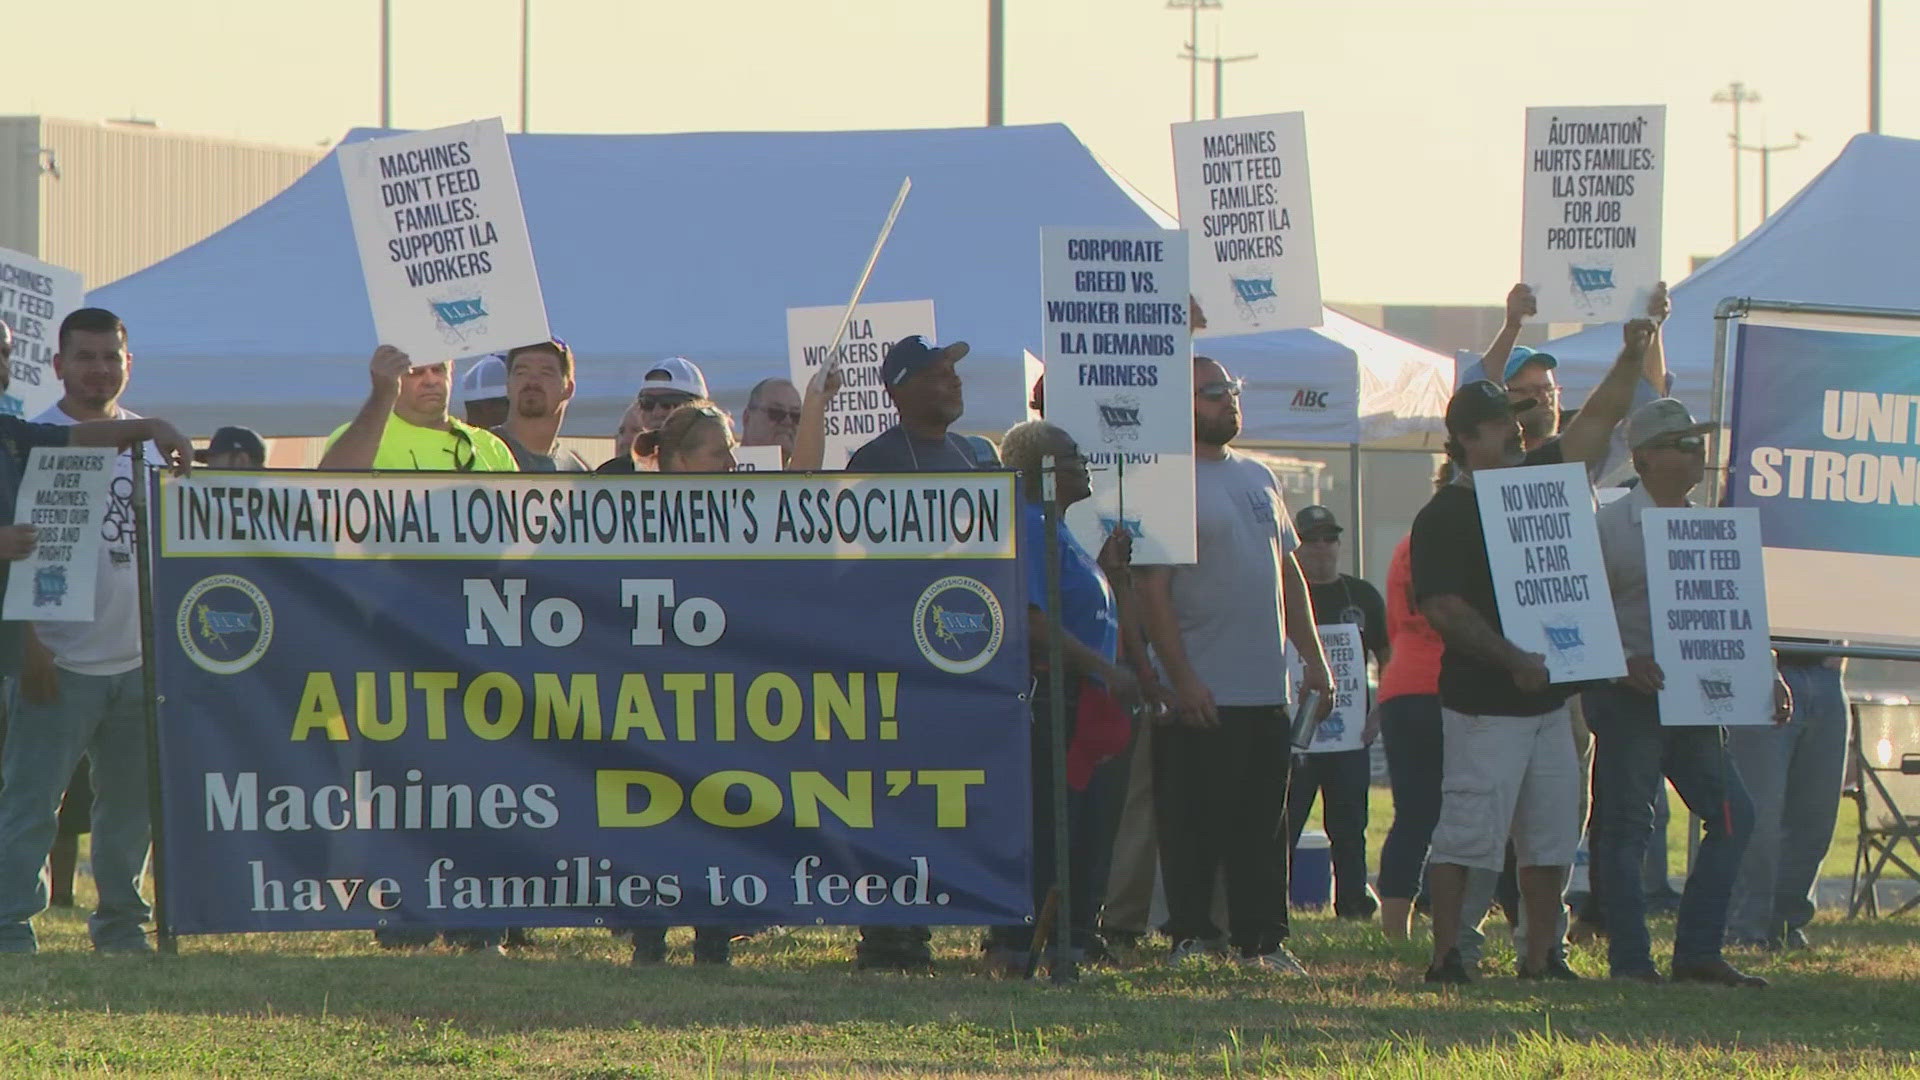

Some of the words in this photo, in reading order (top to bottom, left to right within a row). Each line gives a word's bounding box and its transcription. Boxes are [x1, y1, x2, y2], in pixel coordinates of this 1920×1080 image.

[1203, 131, 1276, 158] MACHINES
[1549, 122, 1641, 145] AUTOMATION
[379, 141, 471, 180] MACHINES
[1203, 160, 1243, 185] DON'T
[1247, 157, 1281, 181] FEED
[1535, 149, 1581, 172] HURTS
[1585, 149, 1655, 171] FAMILIES:
[381, 177, 432, 207] DON'T
[436, 168, 480, 197] FEED
[1211, 183, 1278, 211] FAMILIES:
[1552, 176, 1575, 198] ILA
[1579, 175, 1634, 197] STANDS
[394, 197, 480, 233] FAMILIES:
[1203, 211, 1264, 237] SUPPORT
[1269, 209, 1290, 231] ILA
[1564, 201, 1591, 224] FOR
[1595, 201, 1620, 223] JOB
[388, 227, 465, 262] SUPPORT
[470, 221, 499, 247] ILA
[1068, 239, 1163, 262] CORPORATE
[1215, 235, 1283, 262] WORKERS
[1548, 227, 1636, 250] PROTECTION
[405, 251, 492, 288] WORKERS
[1075, 270, 1125, 293] GREED
[1132, 271, 1158, 294] VS.
[19, 292, 54, 320] FEED
[1048, 301, 1119, 324] WORKER
[1125, 303, 1187, 326] RIGHTS:
[849, 319, 873, 340] ILA
[803, 342, 878, 366] WOKERS
[1061, 332, 1087, 354] ILA
[1093, 333, 1174, 356] DEMANDS
[1079, 364, 1158, 387] FAIRNESS
[1291, 390, 1329, 408] ABC
[843, 414, 875, 435] AND
[56, 455, 104, 471] WORKERS
[54, 473, 80, 488] OVER
[1749, 447, 1920, 506] STRON
[1501, 484, 1523, 512] NO
[1524, 481, 1569, 510] WORK
[31, 509, 68, 524] DEFEND
[69, 509, 90, 524] OUR
[177, 485, 440, 544] INTERNATIONAL
[453, 487, 758, 545] LONGSHOREMEN'S
[774, 487, 1000, 545] ASSOCIATION
[60, 528, 80, 543] AND
[1507, 512, 1572, 543] WITHOUT
[1667, 519, 1737, 540] MACHINES
[37, 545, 72, 561] RIGHTS
[1524, 547, 1536, 574] A
[1537, 545, 1571, 573] FAIR
[1669, 549, 1706, 571] DON'T
[1710, 550, 1740, 570] FEED
[1515, 575, 1590, 607] CONTRACT
[1675, 579, 1739, 601] FAMILIES:
[462, 578, 584, 648] No
[619, 578, 727, 647] To
[916, 596, 931, 655] INTERNATIONAL
[927, 578, 991, 600] LONGSHOREMEN'S
[988, 601, 1001, 654] ASSOCIATION
[1667, 609, 1726, 631] SUPPORT
[1730, 609, 1752, 630] ILA
[256, 600, 271, 654] ASSOCIATION
[1331, 647, 1354, 662] FEED
[1679, 639, 1745, 660] WORKERS
[290, 671, 899, 742] AUTOMATION!
[204, 769, 560, 832] Machines
[595, 769, 986, 830] DON'T
[247, 860, 402, 912] have
[425, 856, 682, 910] families
[706, 866, 768, 908] to
[791, 855, 951, 907] feed.
